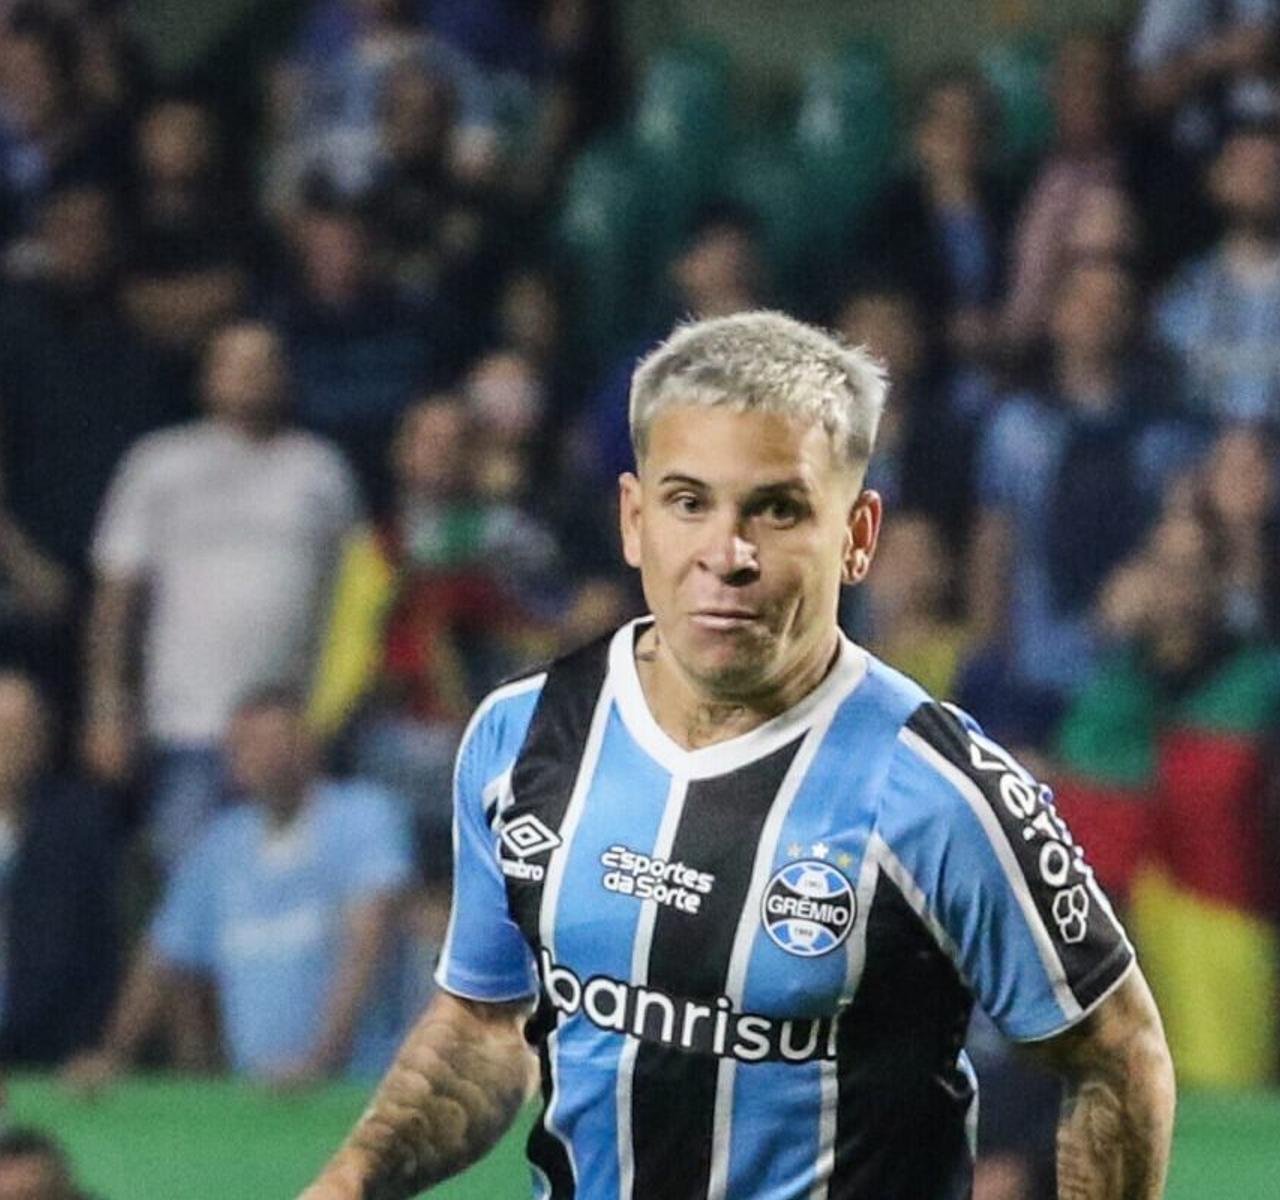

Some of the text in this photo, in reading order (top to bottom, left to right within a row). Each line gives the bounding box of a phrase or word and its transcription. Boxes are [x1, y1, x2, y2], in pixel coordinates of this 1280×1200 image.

[601, 846, 715, 893] Esportes
[767, 894, 849, 926] GRÊMIO
[538, 949, 839, 1061] banrisul
